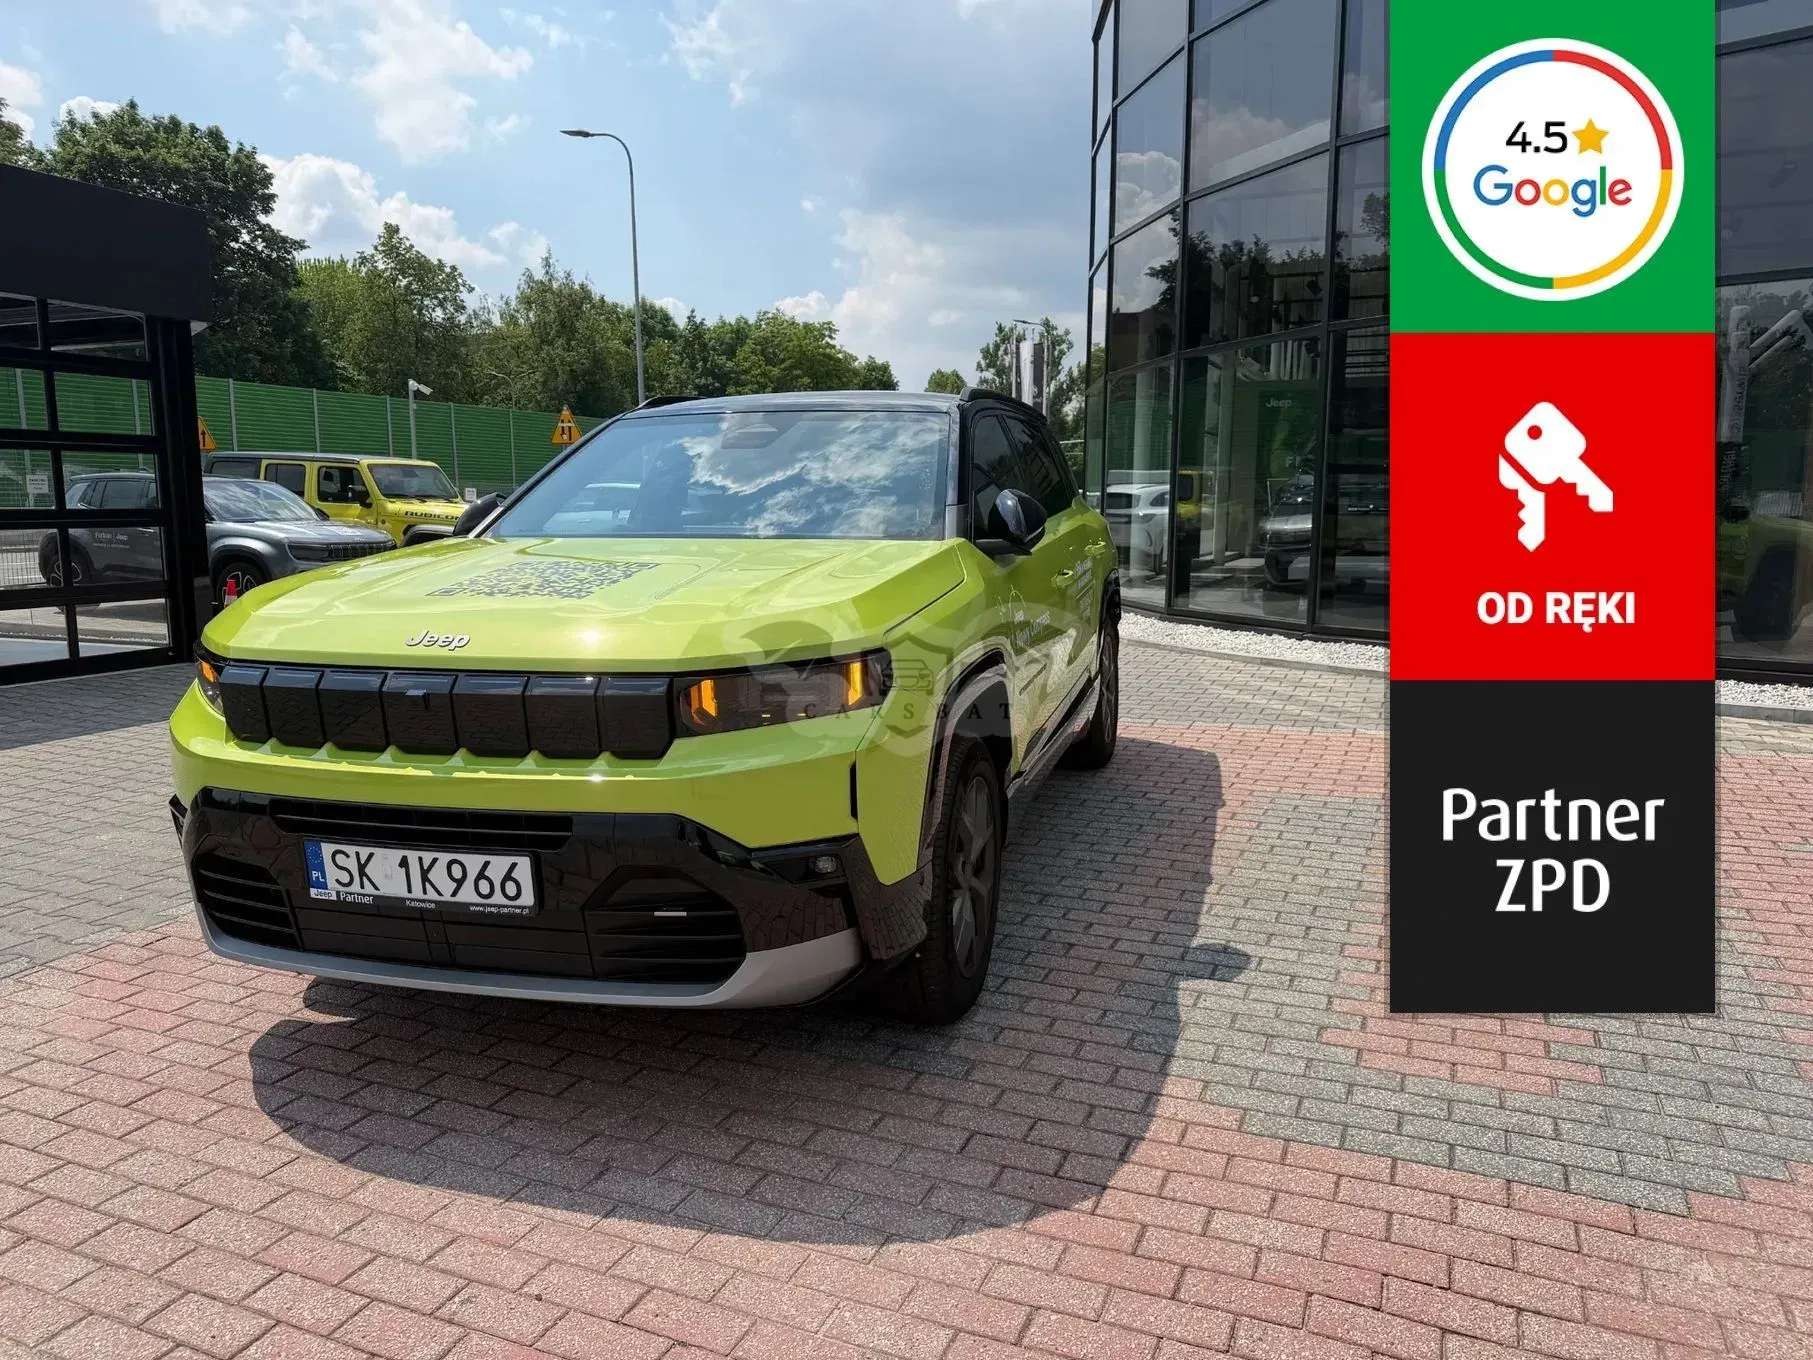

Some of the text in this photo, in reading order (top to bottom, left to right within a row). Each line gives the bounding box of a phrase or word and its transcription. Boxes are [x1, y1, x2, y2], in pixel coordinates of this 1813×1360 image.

[1266, 397, 1293, 409] Jeep
[405, 628, 471, 652] Jeep
[312, 870, 325, 882] PL
[331, 849, 522, 901] SK 1K966
[314, 889, 333, 899] Jeep
[340, 892, 374, 905] Partner
[405, 899, 436, 910] Katowice
